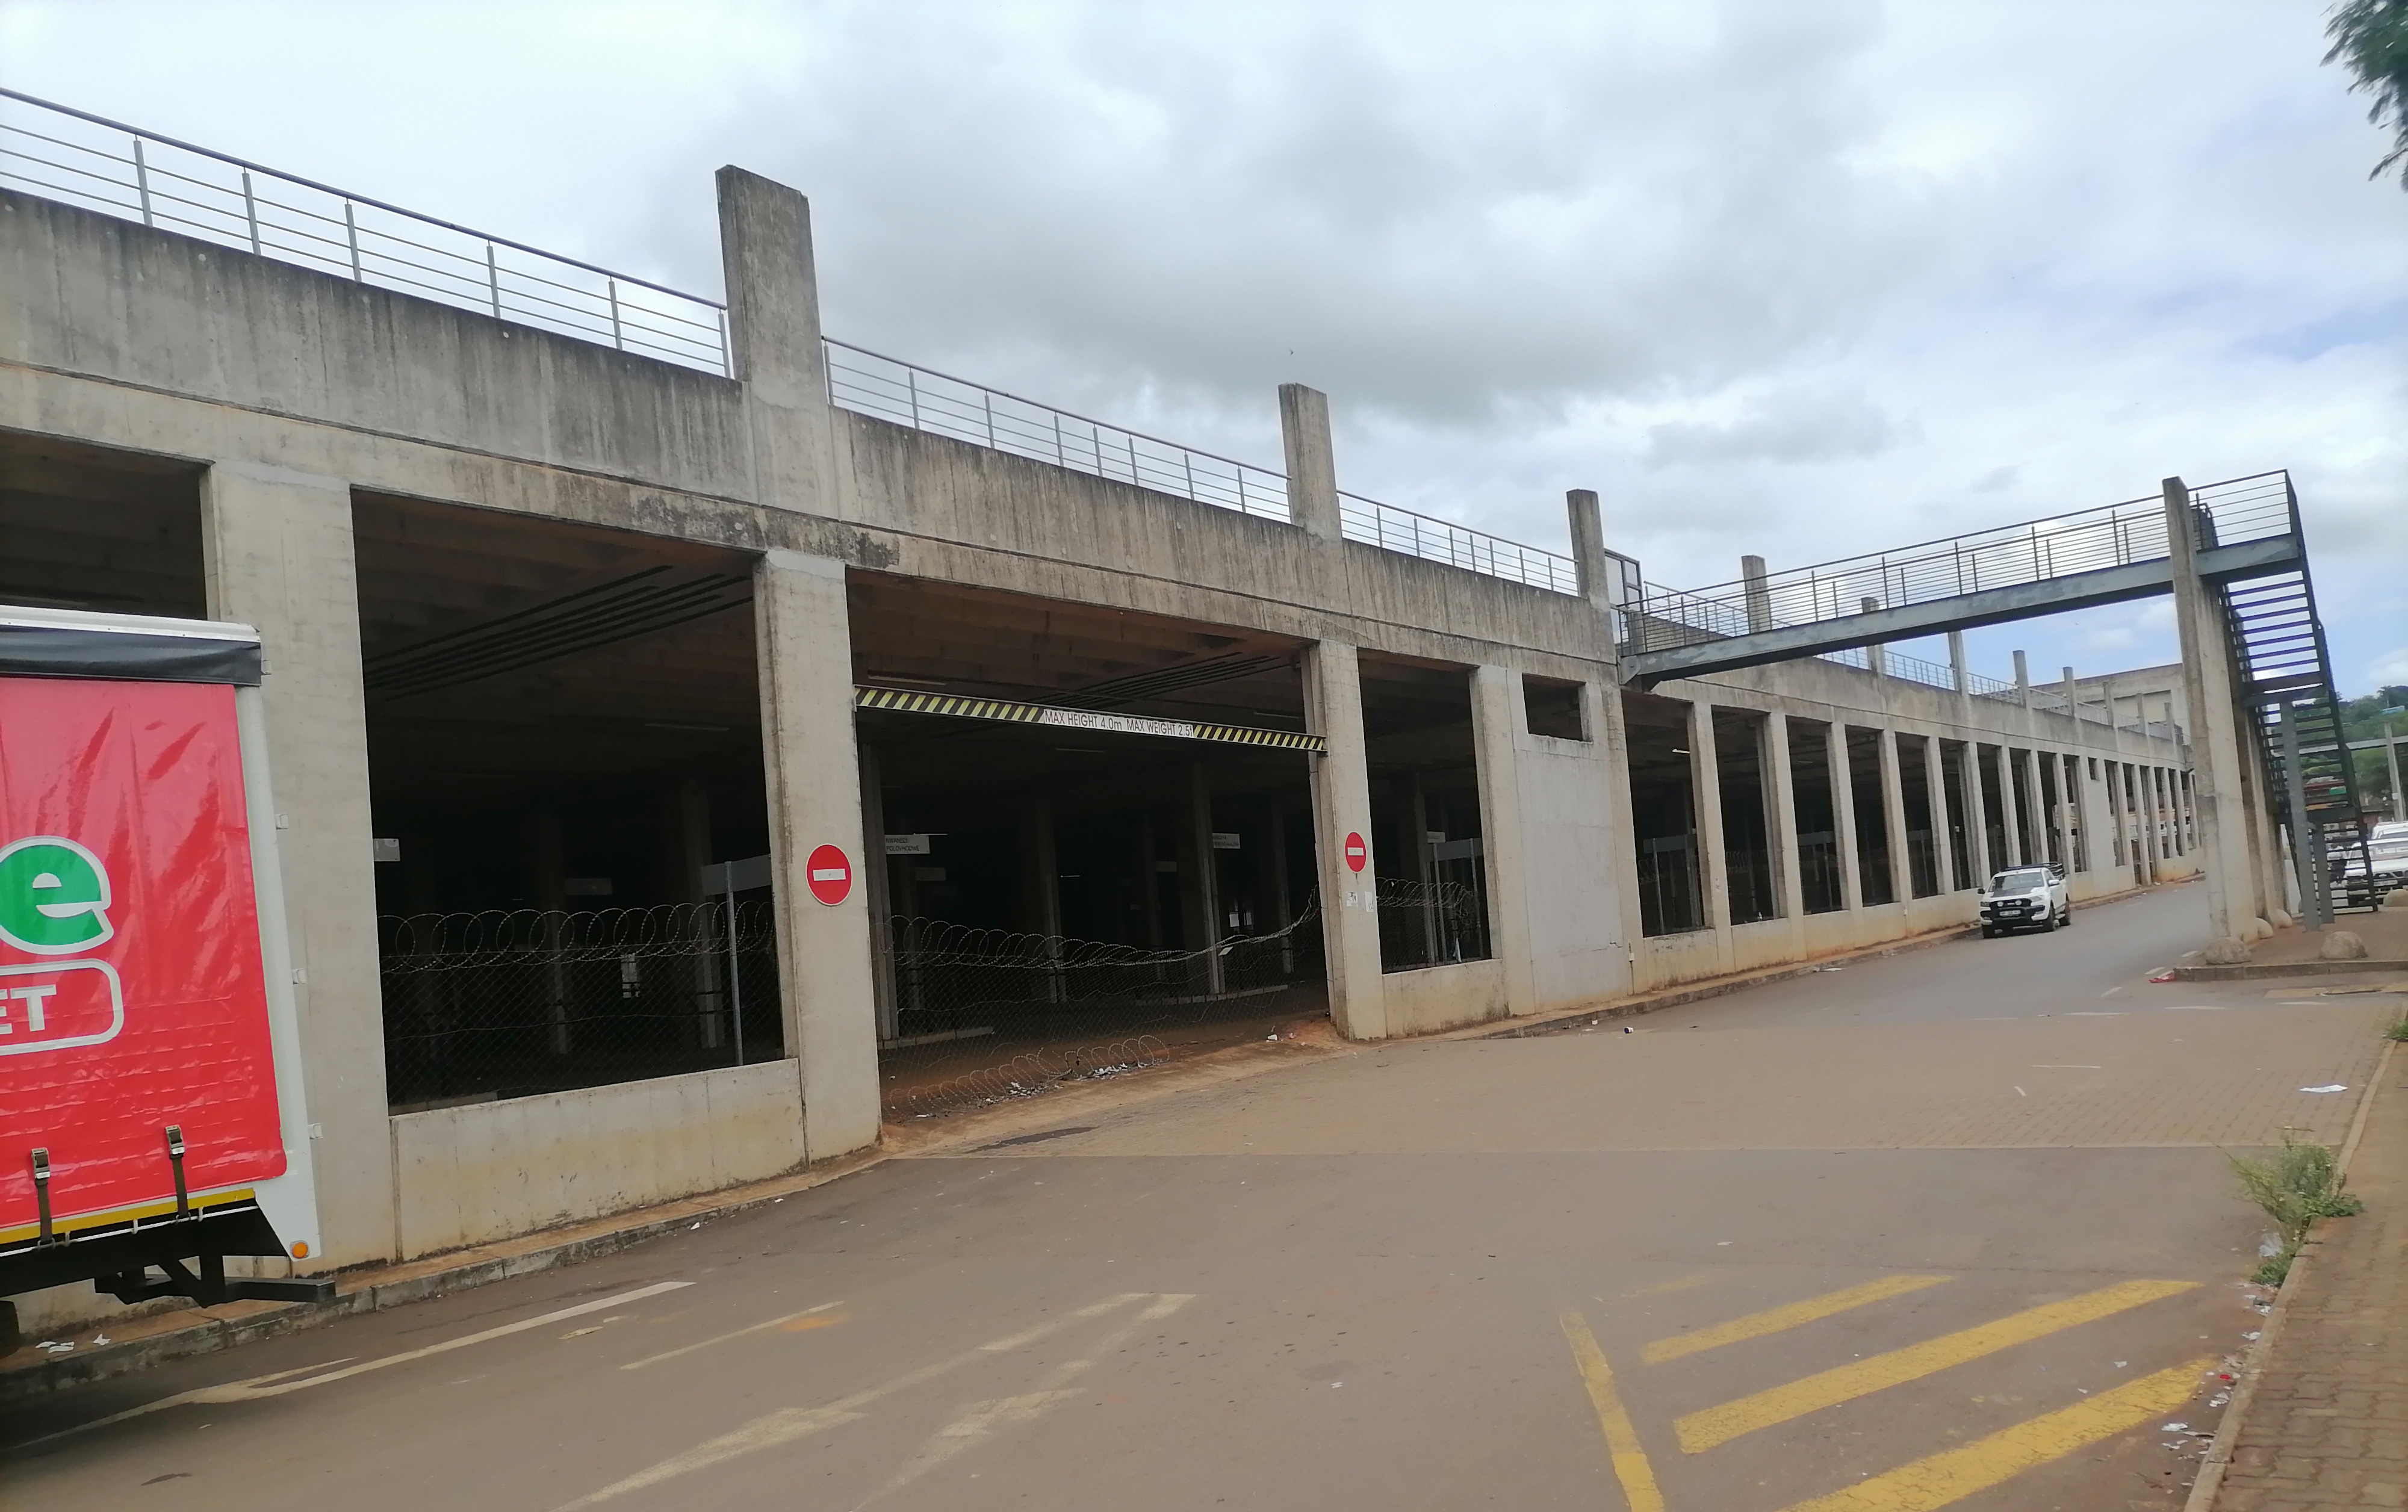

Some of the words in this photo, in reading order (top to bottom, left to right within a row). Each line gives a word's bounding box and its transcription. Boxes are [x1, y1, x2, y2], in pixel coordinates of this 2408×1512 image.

[1044, 710, 1064, 724] MAX
[1067, 713, 1097, 728] HEIGHT
[1100, 717, 1122, 731] 4.0m
[1126, 719, 1145, 732] MAX
[1147, 720, 1176, 736] WEIGHT
